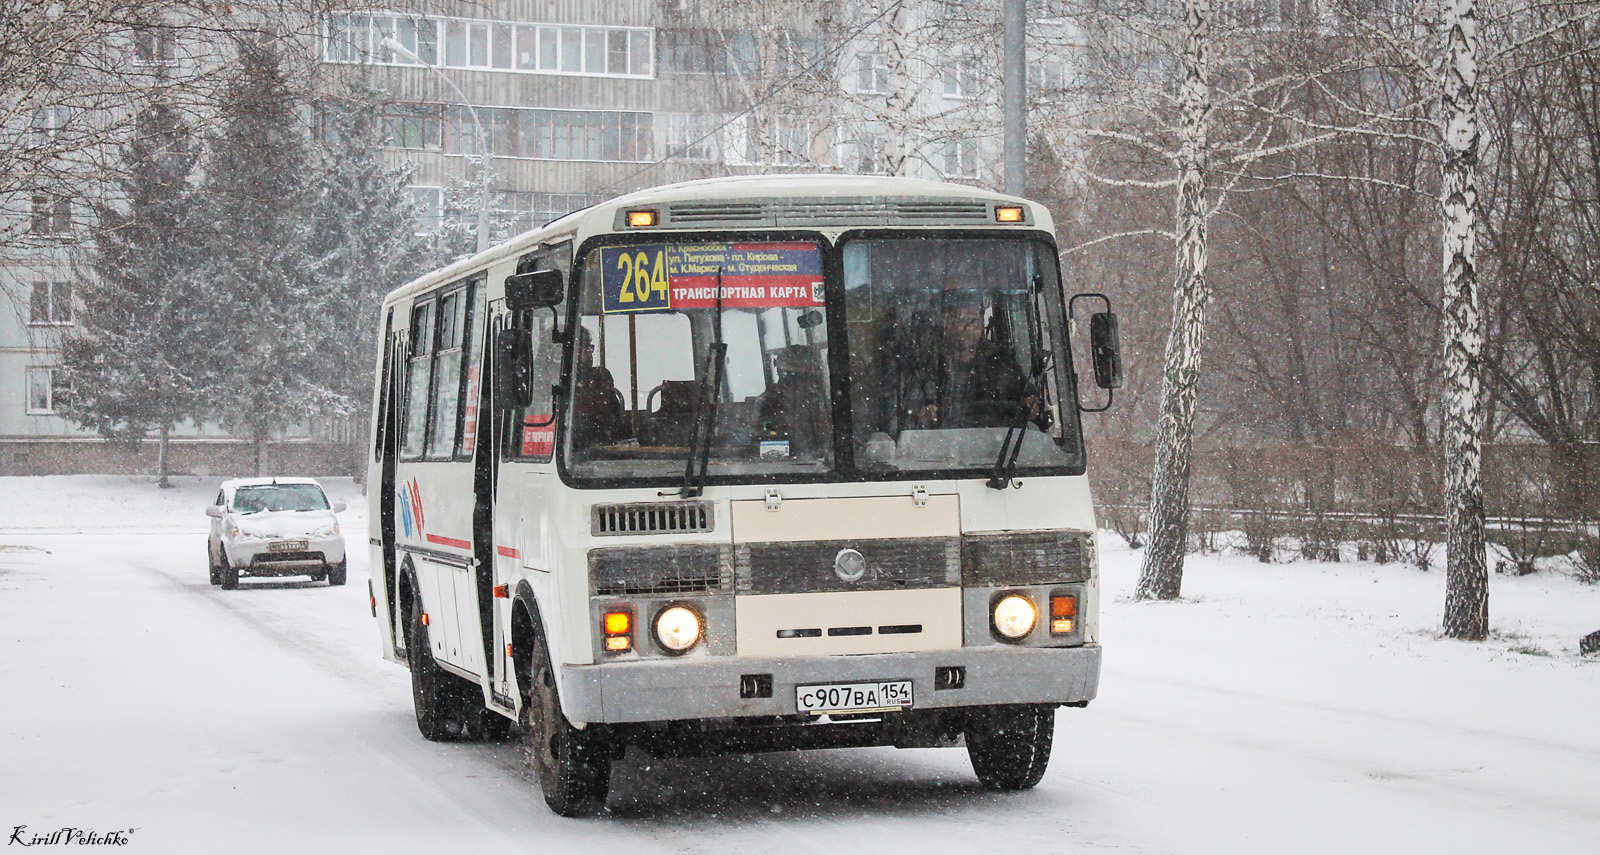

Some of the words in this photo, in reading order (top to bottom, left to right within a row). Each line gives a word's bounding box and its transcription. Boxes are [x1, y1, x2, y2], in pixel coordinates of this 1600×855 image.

[669, 256, 681, 265] ул.
[684, 253, 725, 264] Петухова
[747, 252, 778, 263] Кирова
[670, 266, 679, 274] м.
[738, 262, 798, 273] Студенческая
[617, 250, 667, 303] 264
[673, 287, 765, 300] ТРАНСПОРТНАЯ
[770, 287, 807, 298] КАРТА
[803, 688, 877, 707] С907ВА
[881, 684, 908, 699] 154
